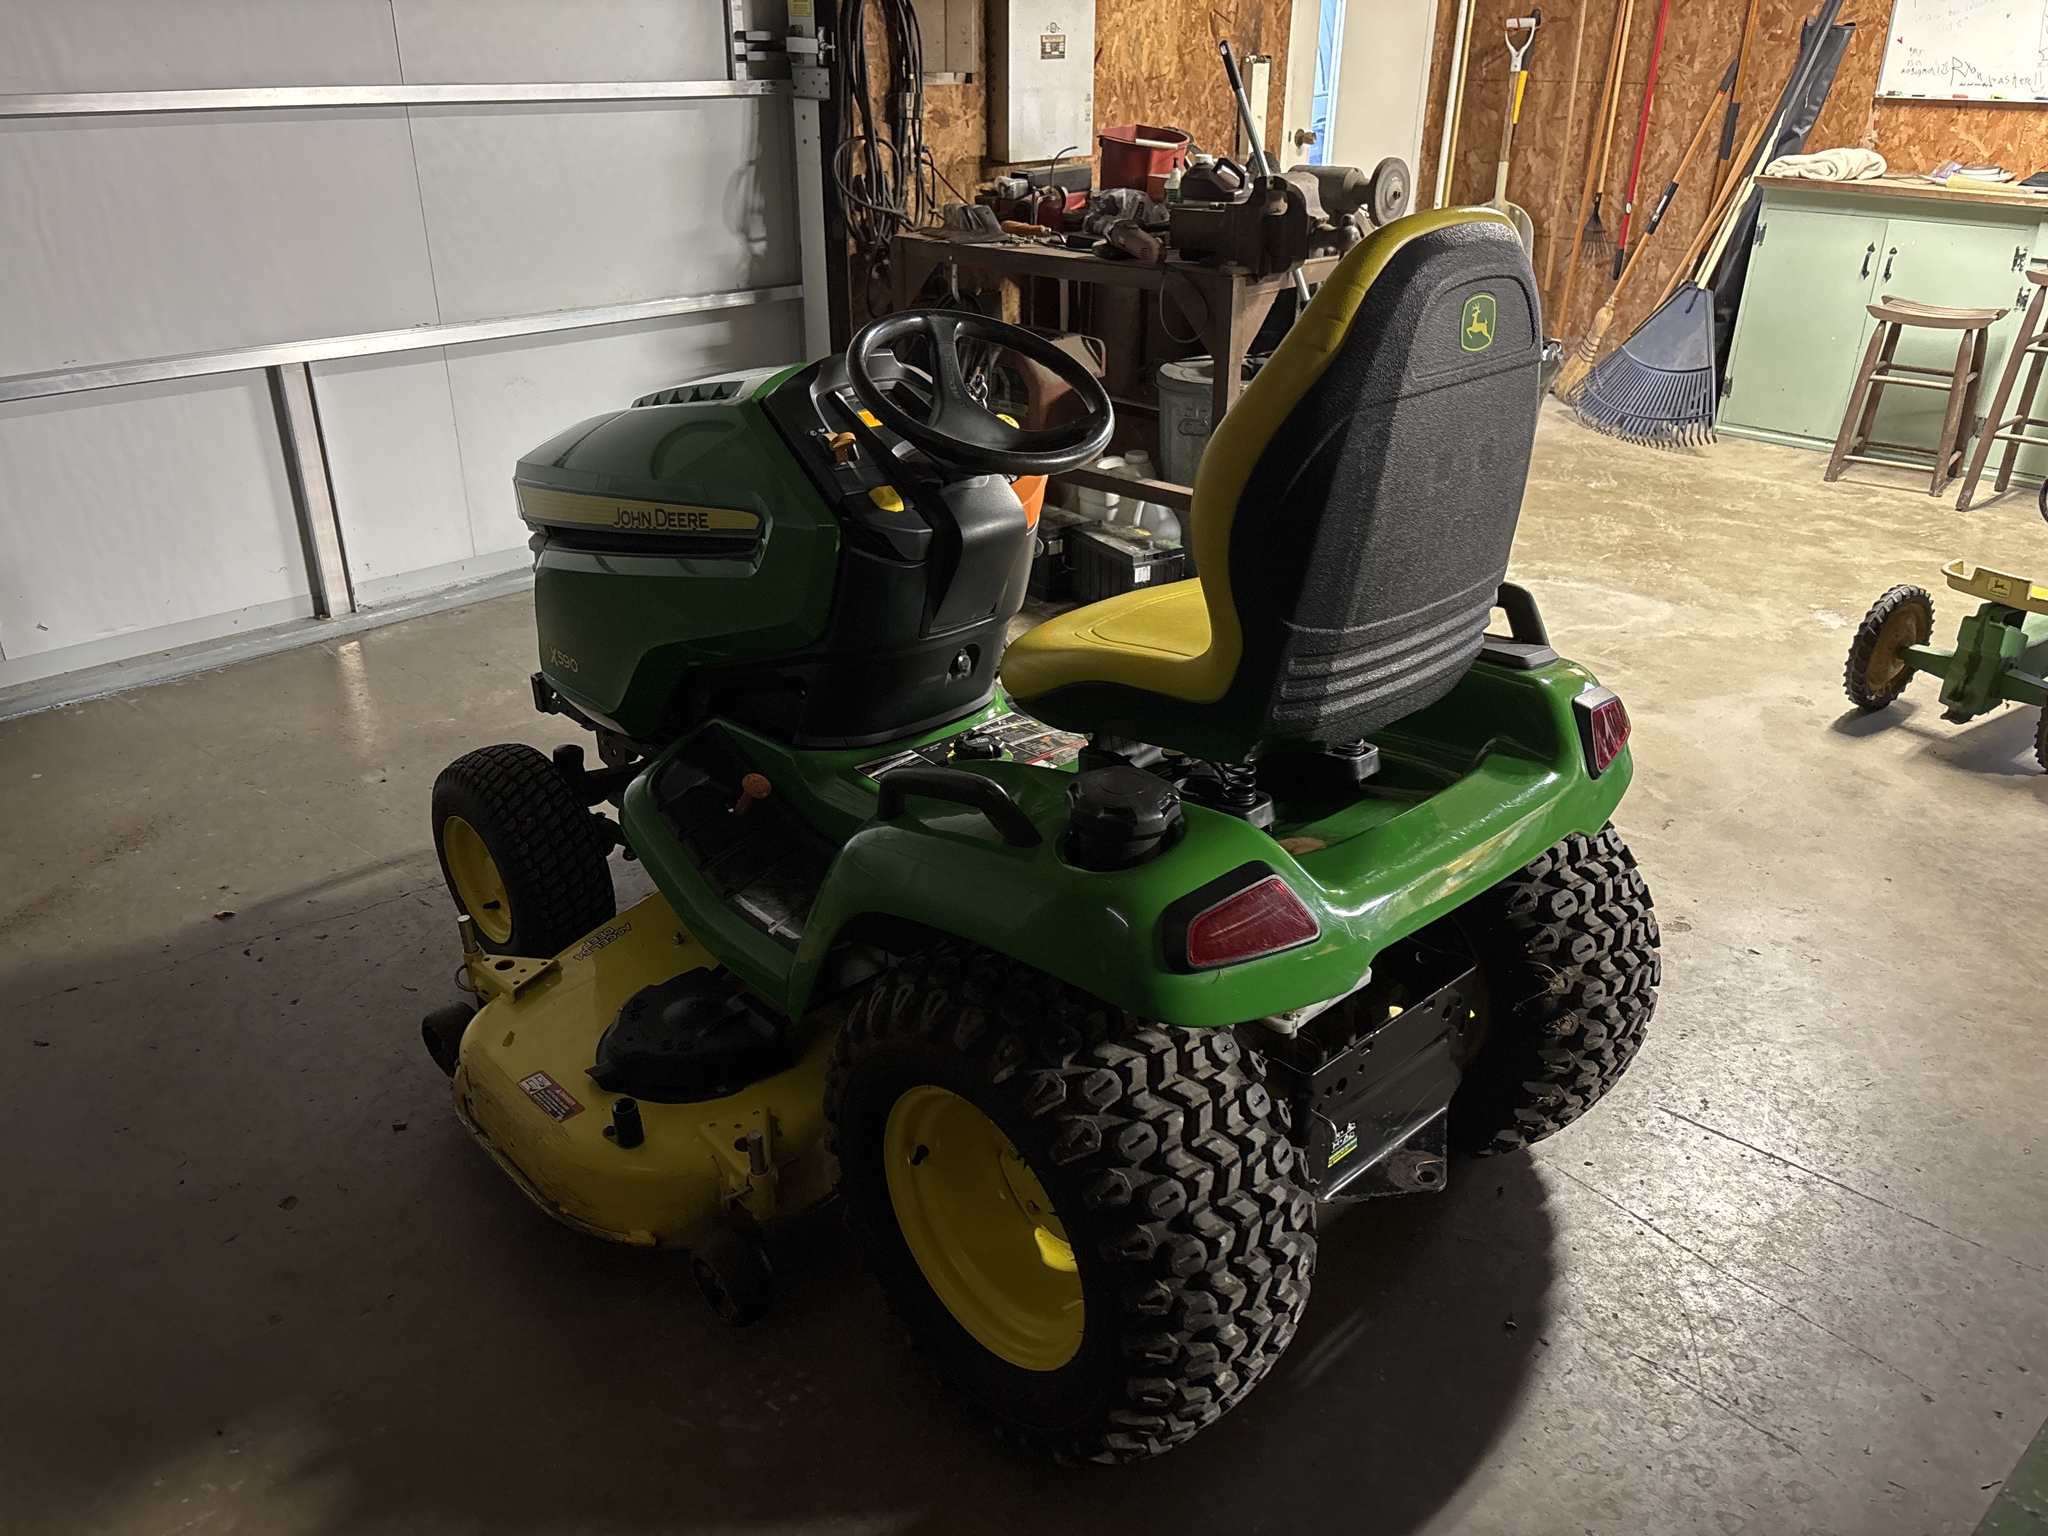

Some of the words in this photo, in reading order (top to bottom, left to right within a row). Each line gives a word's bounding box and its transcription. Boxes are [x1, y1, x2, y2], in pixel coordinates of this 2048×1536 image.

[614, 507, 652, 527] JOHN
[654, 508, 709, 528] DEERE
[548, 644, 579, 674] X590
[582, 926, 615, 951] DEEP
[592, 922, 632, 949] ACCEL
